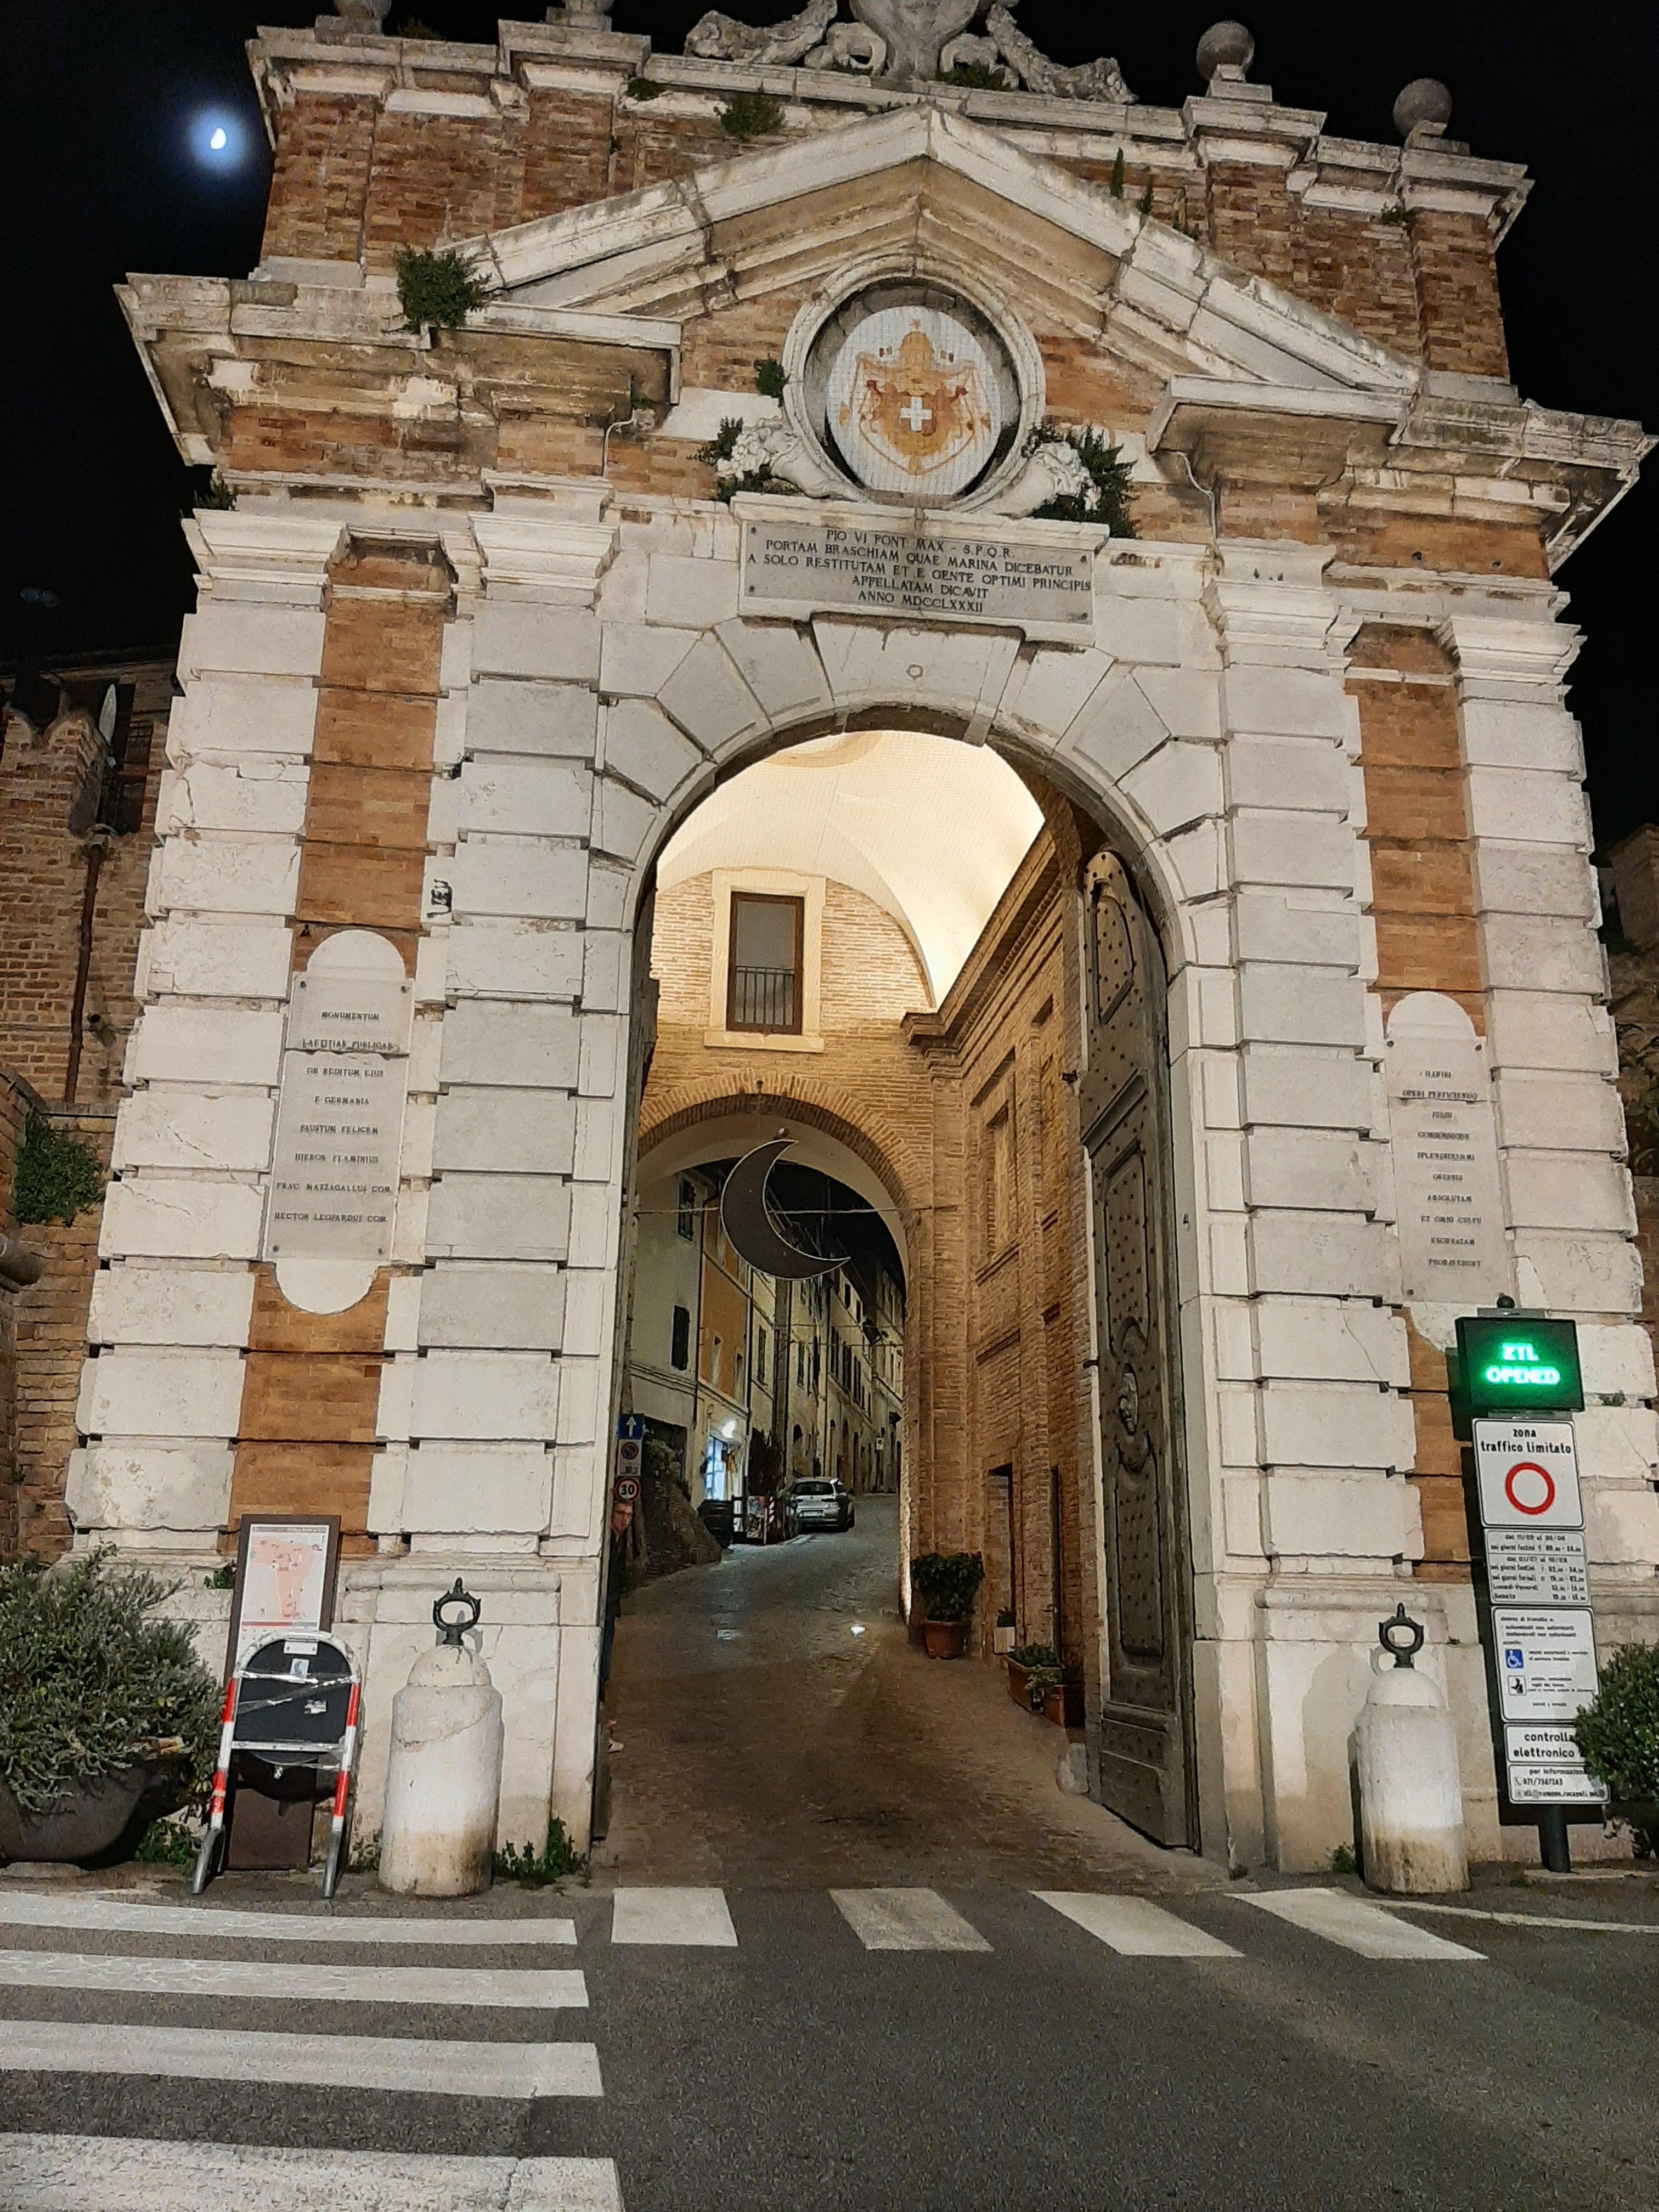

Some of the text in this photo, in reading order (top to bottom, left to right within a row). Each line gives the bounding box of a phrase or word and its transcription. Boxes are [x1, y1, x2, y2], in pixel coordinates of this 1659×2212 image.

[827, 529, 847, 541] PIO
[854, 531, 867, 543] VI
[874, 533, 907, 548] PONT
[916, 537, 944, 552] MAX
[766, 539, 1073, 575] PORTAM BRASCHIAM QUAE MARINA DICEBATUR
[747, 553, 1091, 592] A SOLO RESTITUTAM ET E GENTE OPTIMI PRINCIPIS
[852, 575, 989, 598] APPELLATAM DICAVIT
[857, 590, 983, 613] ANNO MDCCLXXXII
[321, 1012, 380, 1021] MONUMENTUM
[307, 1067, 318, 1075] OB
[323, 1068, 360, 1077] REDITUM
[324, 1096, 370, 1105] GERMANIA
[301, 1125, 379, 1135] FAUSTUM FELICEM
[333, 1154, 379, 1164] FLAMINIUS
[306, 1183, 367, 1192] MAZZAGALLUS
[1427, 1194, 1472, 1203] ABSOLUTAM
[274, 1212, 309, 1221] HECTOR
[314, 1213, 363, 1222] LEOPARDUS
[1513, 1428, 1537, 1437] zona
[1481, 1440, 1571, 1454] traffico limitato
[620, 1484, 635, 1496] 30
[1514, 1747, 1575, 1757] elettronico
